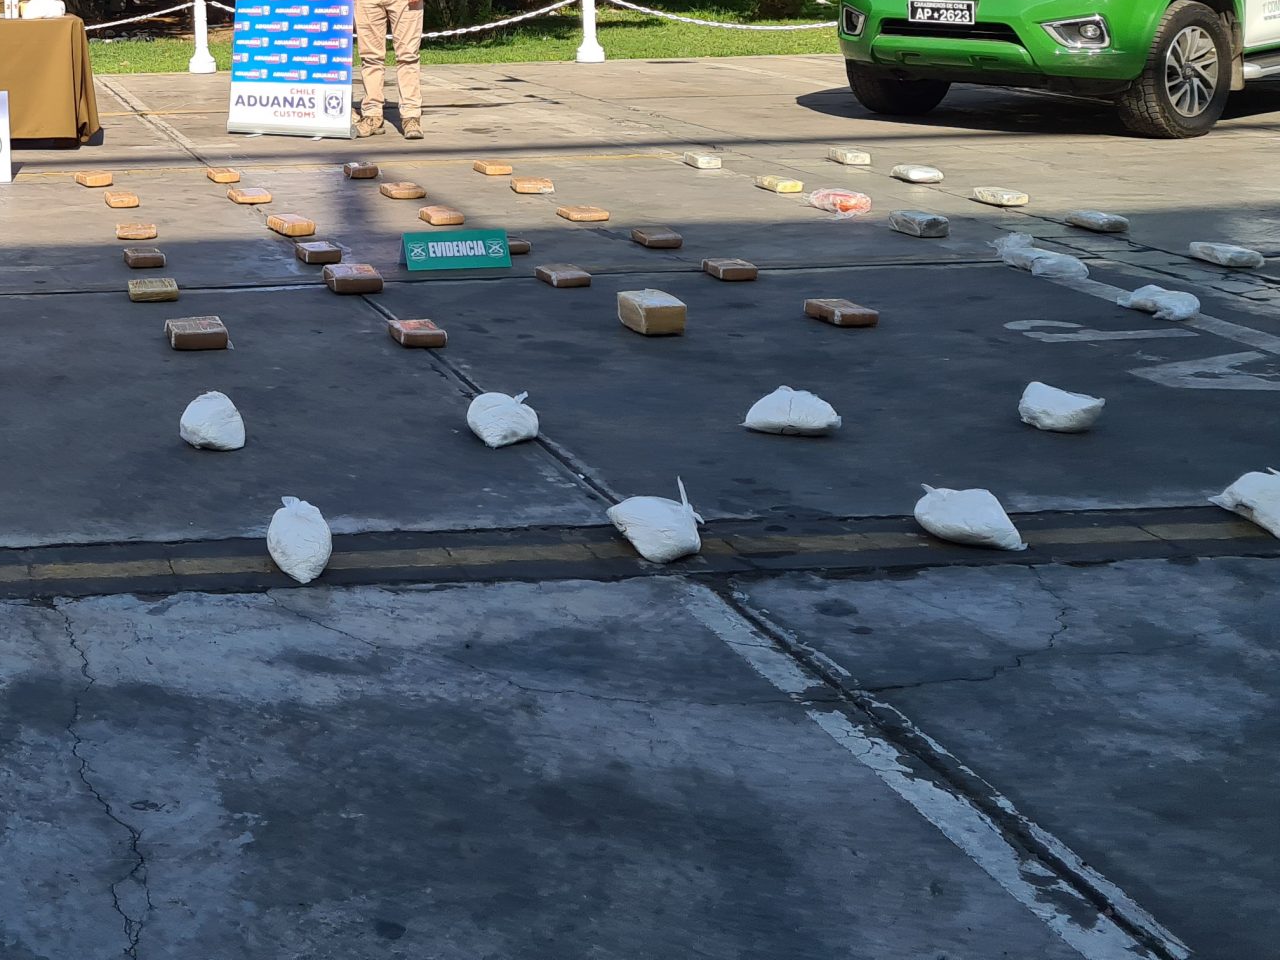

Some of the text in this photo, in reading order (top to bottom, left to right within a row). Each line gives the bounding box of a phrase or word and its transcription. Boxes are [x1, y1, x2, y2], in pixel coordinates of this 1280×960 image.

[916, 8, 970, 22] AP 2623
[235, 95, 315, 109] ADUANAS
[428, 240, 486, 258] EVIDENCIA
